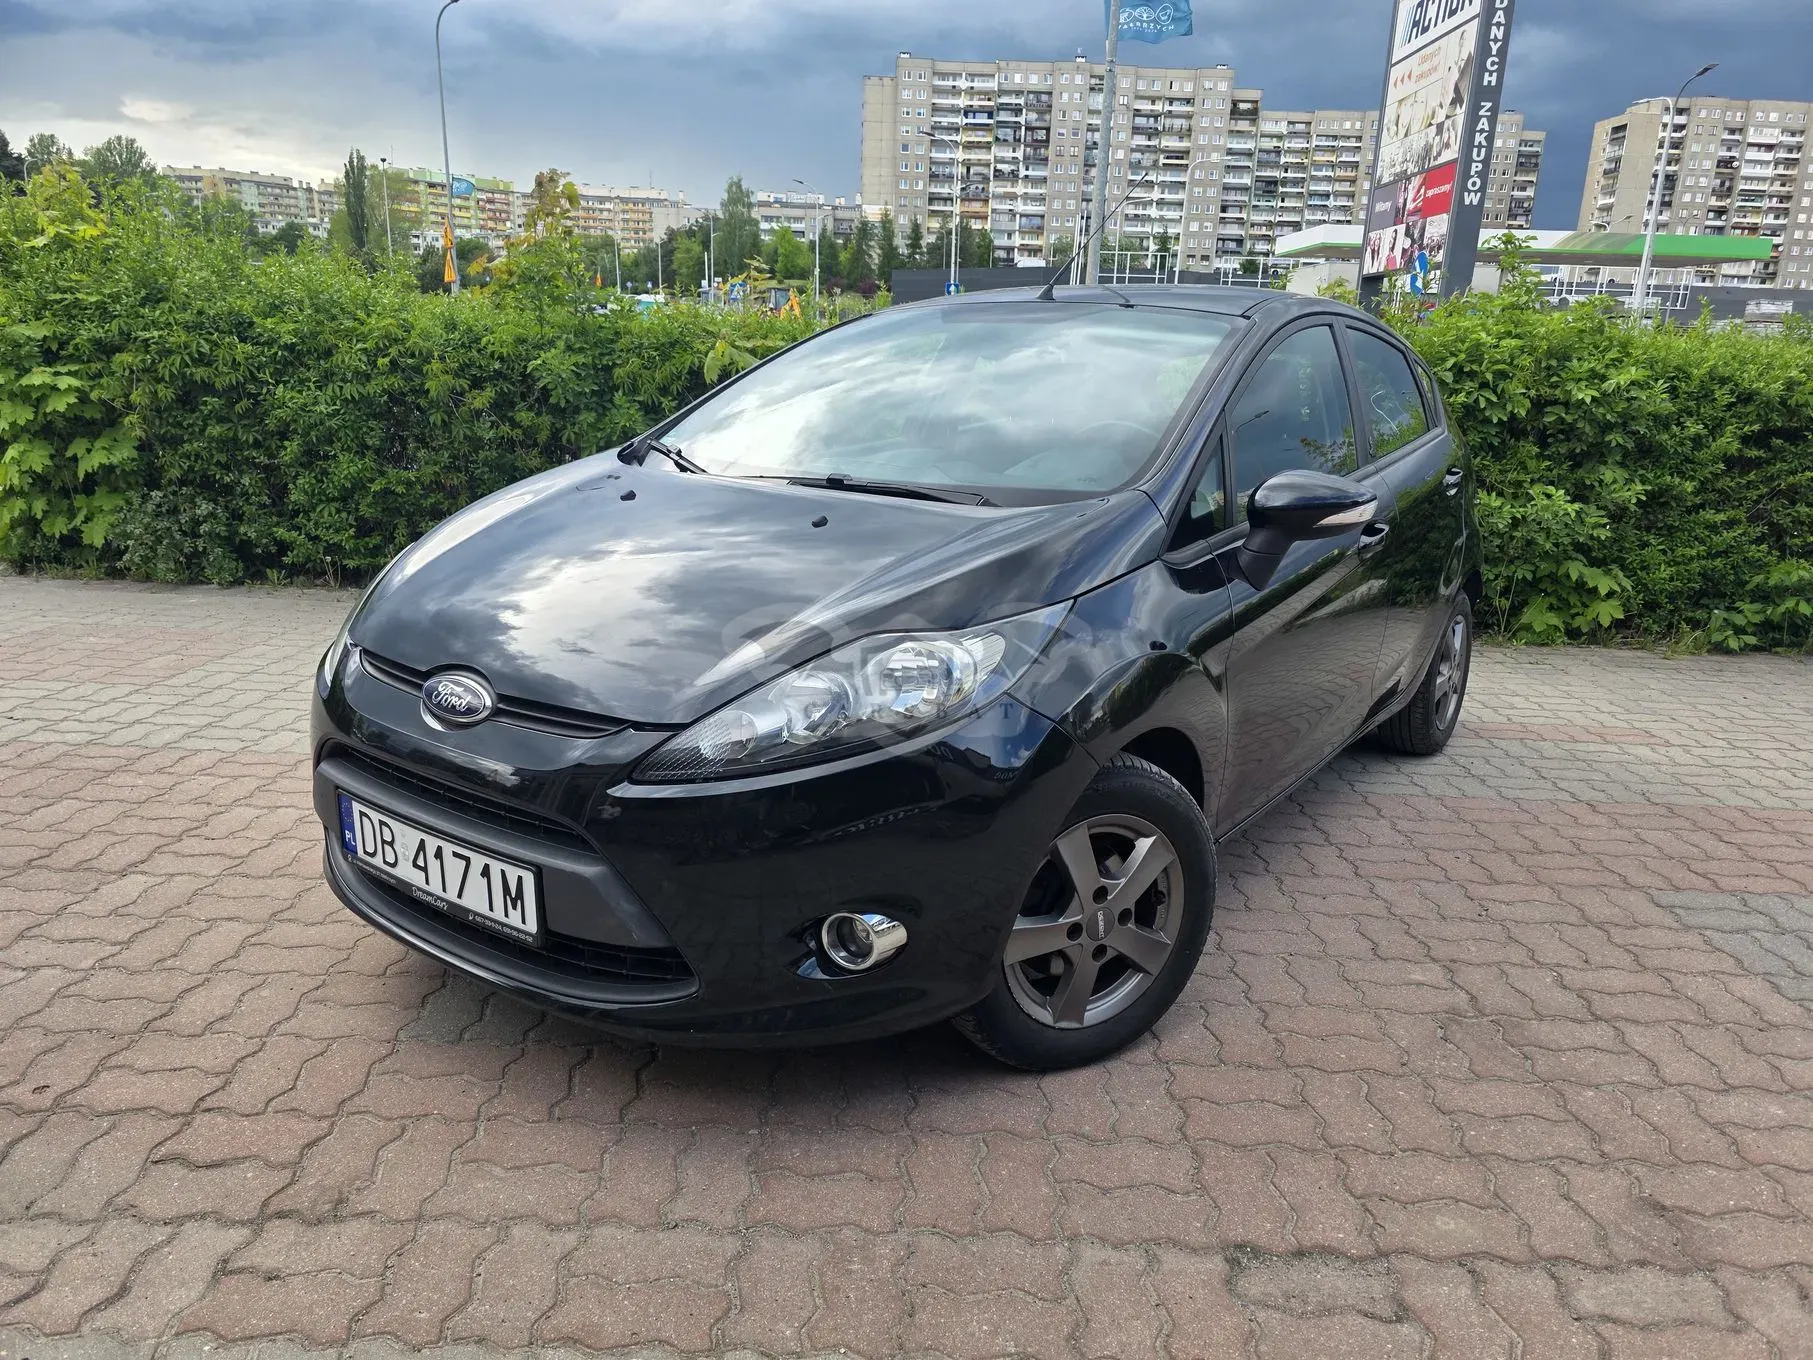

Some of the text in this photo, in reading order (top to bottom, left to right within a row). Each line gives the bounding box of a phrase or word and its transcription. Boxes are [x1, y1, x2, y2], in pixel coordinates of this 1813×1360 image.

[1407, 0, 1473, 44] ACTI
[1464, 102, 1493, 205] ZAKUPÓW
[431, 681, 472, 712] Ford
[345, 829, 356, 846] PL
[358, 808, 527, 926] DB 4171M
